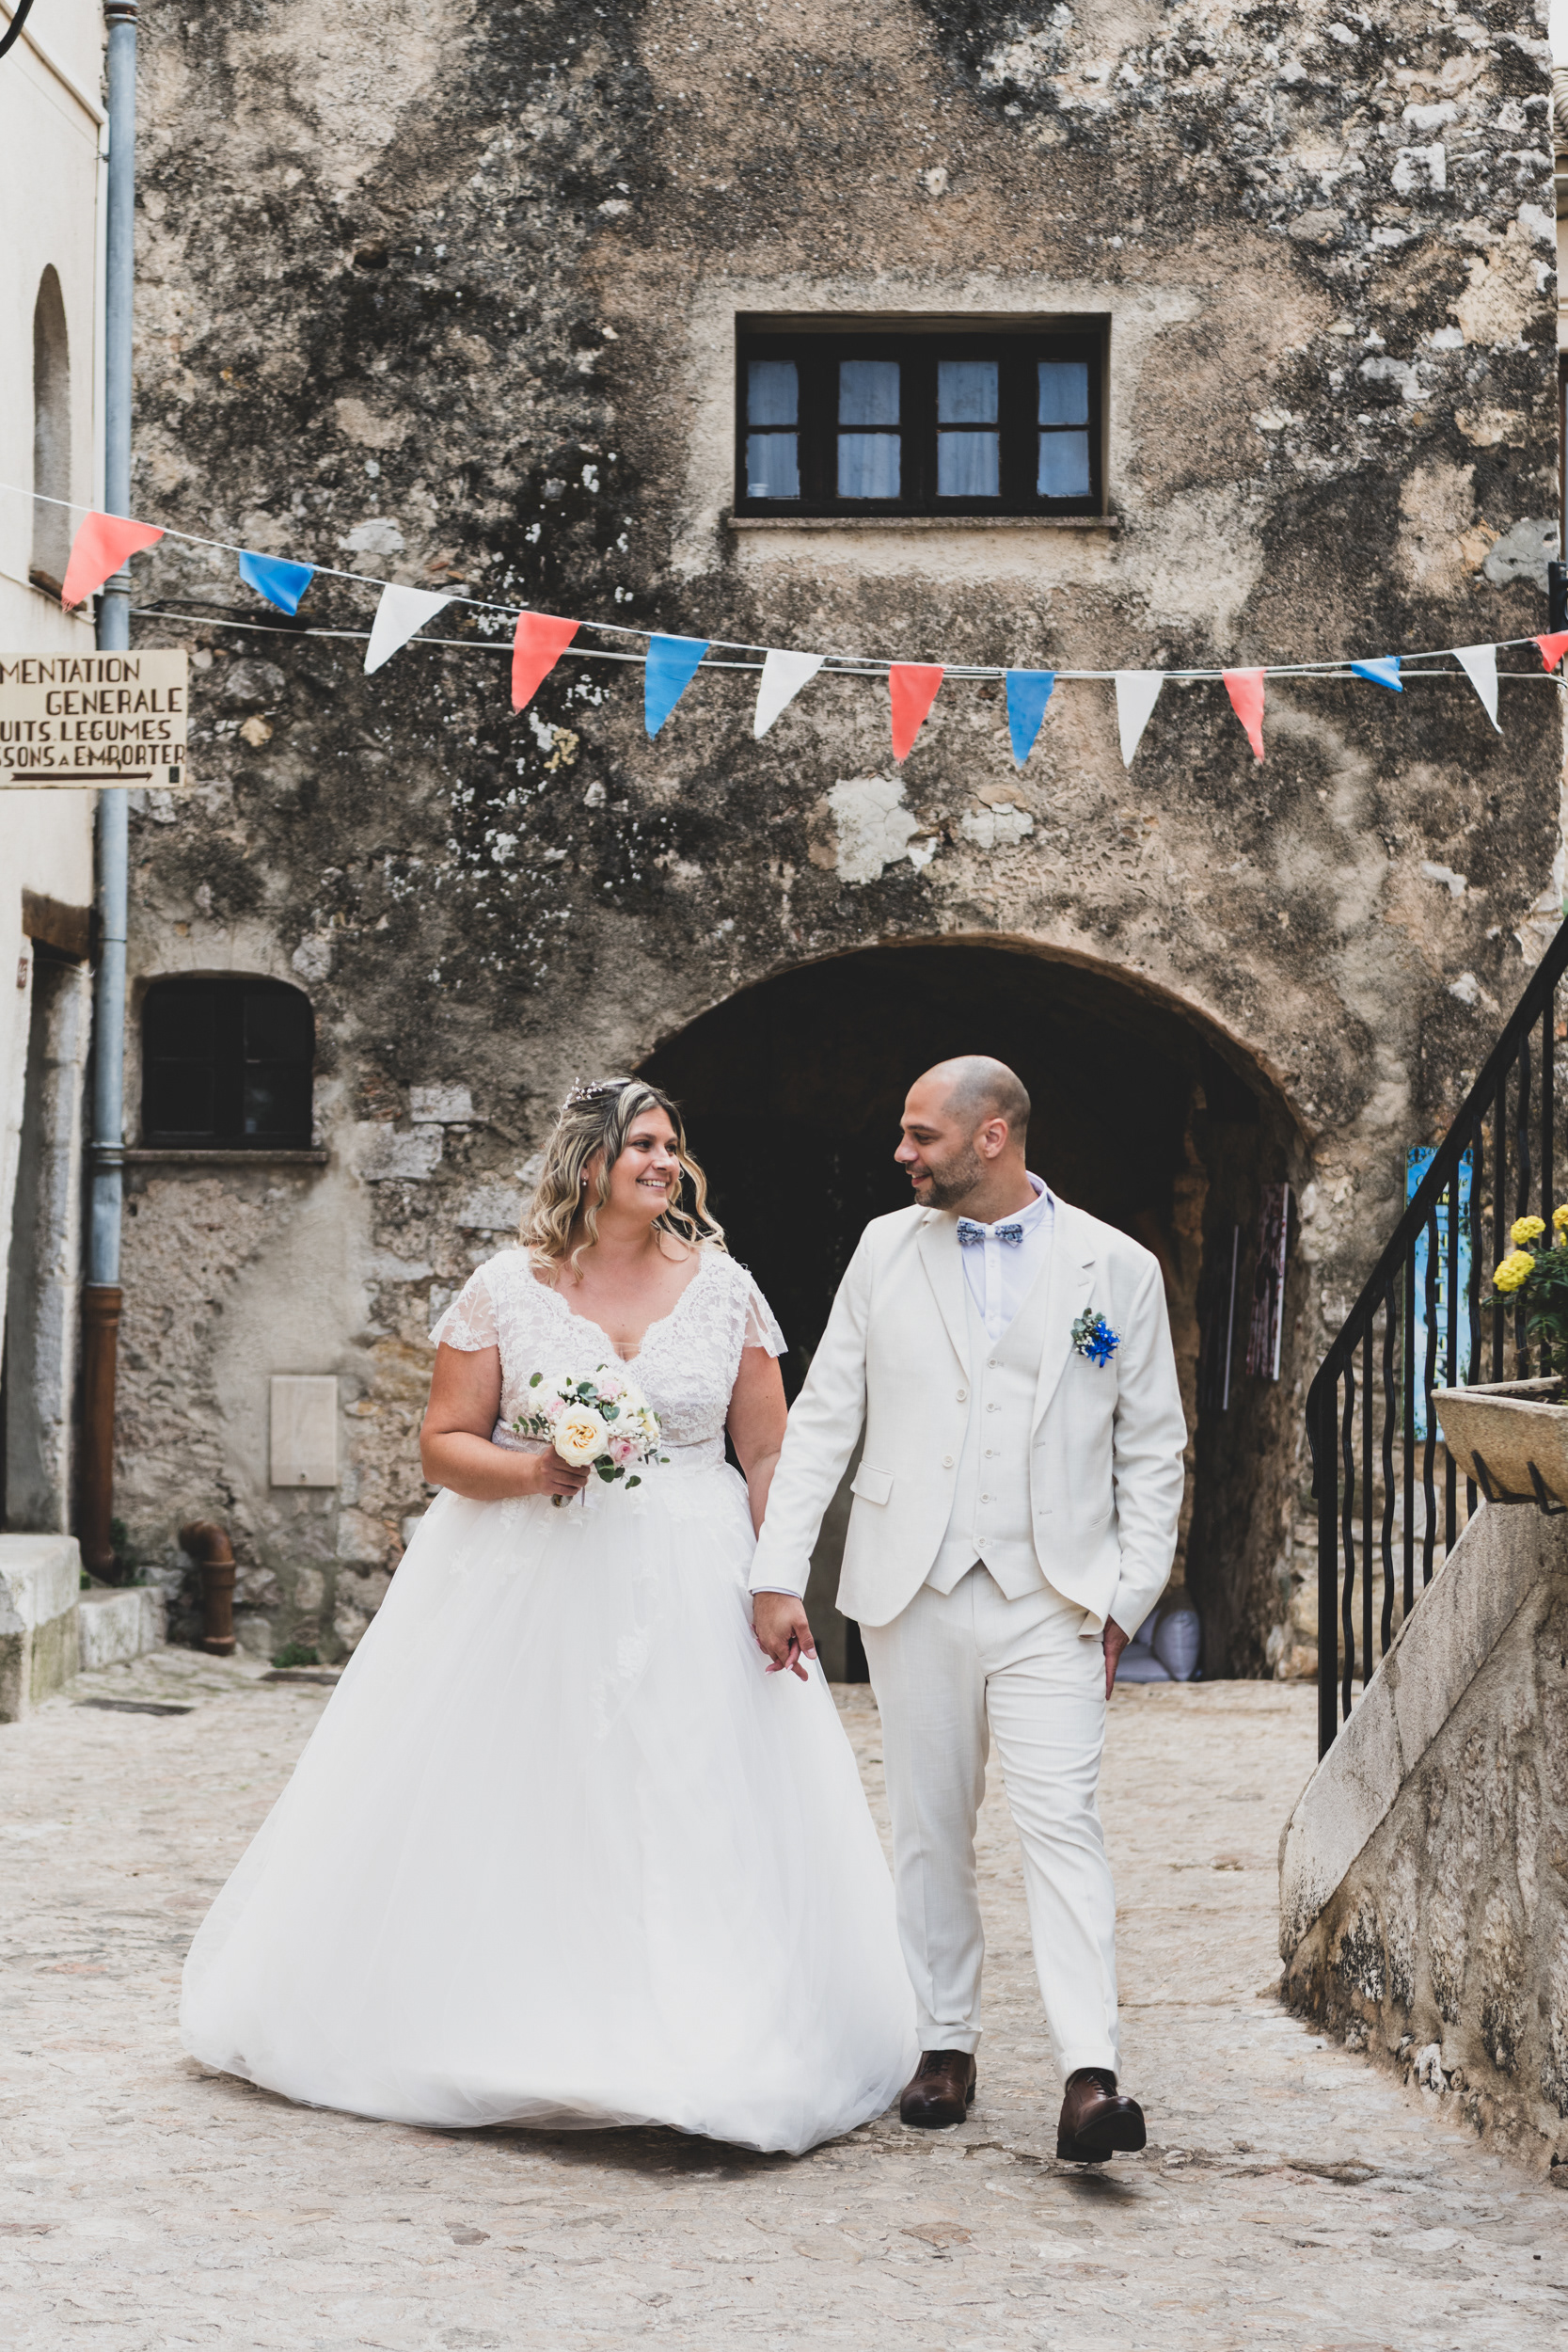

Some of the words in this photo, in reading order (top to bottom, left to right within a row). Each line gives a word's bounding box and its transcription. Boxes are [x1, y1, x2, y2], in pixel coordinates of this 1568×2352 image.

[0, 658, 140, 685] MENTATION
[46, 688, 183, 716] GENERALE
[60, 720, 171, 741] LEGUMES
[0, 745, 55, 768] SONS
[74, 744, 185, 767] EMPORTER
